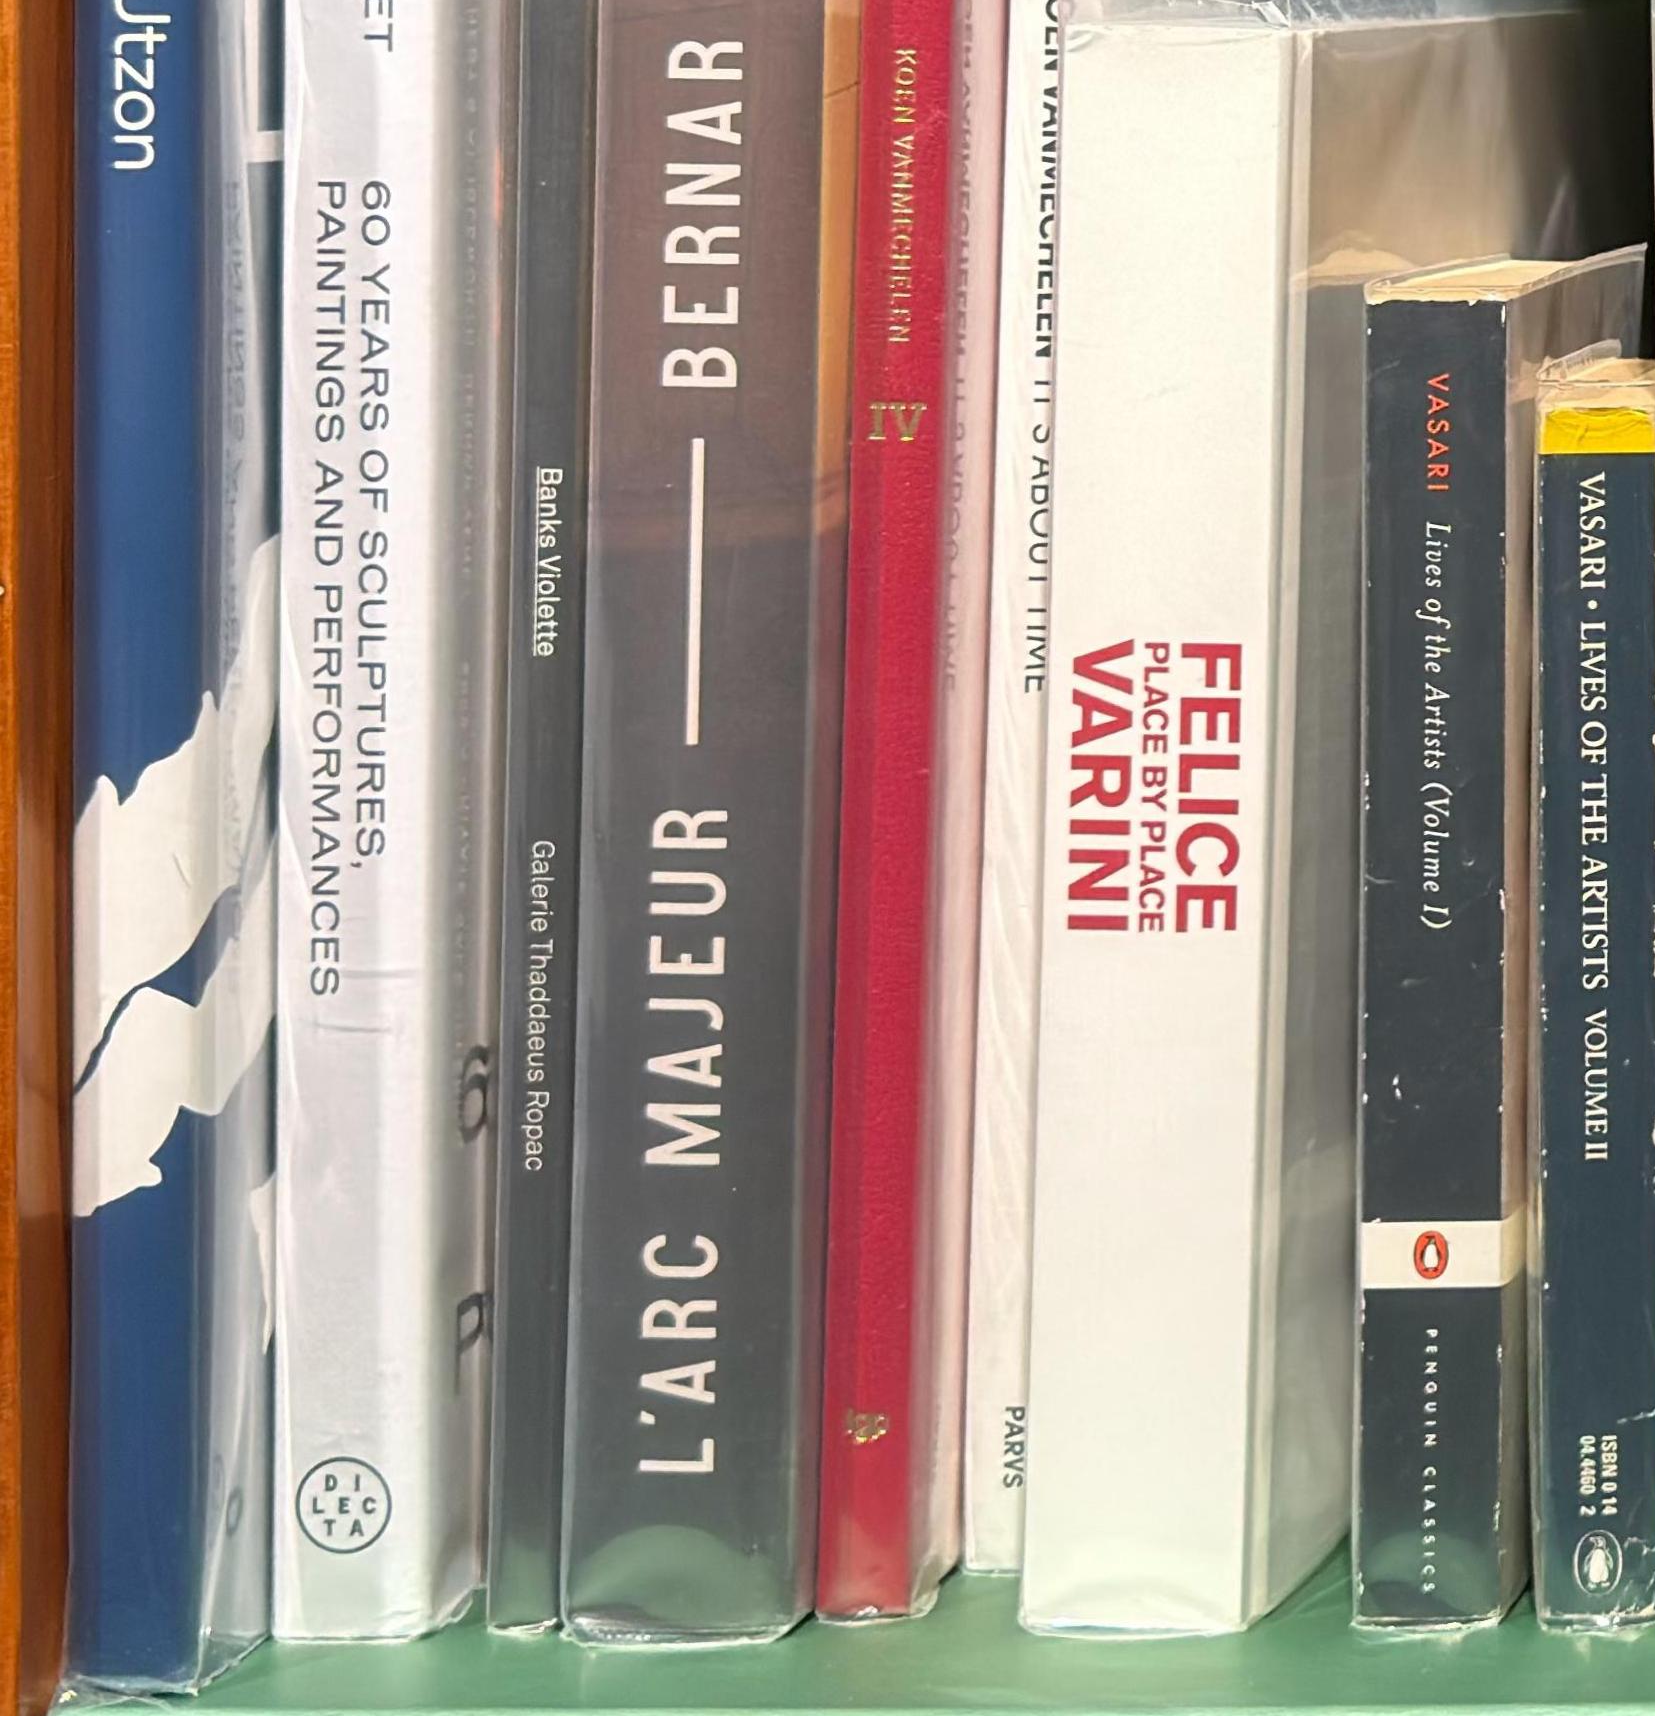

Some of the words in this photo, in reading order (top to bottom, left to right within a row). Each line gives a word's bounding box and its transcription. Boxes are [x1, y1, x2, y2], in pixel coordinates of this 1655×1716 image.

[359, 179, 392, 246] 60
[661, 41, 743, 388] BERNAR
[313, 180, 348, 444] PAINTINGS
[358, 262, 390, 432] YEARS
[868, 402, 927, 442] IV
[1426, 372, 1450, 493] VASARI
[313, 460, 345, 567] AND
[358, 450, 389, 515] OF
[536, 467, 564, 550] Banks
[1578, 473, 1607, 590] VASARI
[533, 556, 559, 658] Violette
[1424, 521, 1451, 588] Lives
[1416, 596, 1450, 623] of
[1424, 627, 1449, 673] the
[350, 528, 389, 872] SCULPTURES,
[1142, 641, 1171, 758] PLACE
[1579, 621, 1607, 711] LIVES
[1423, 682, 1450, 770] Artists
[1579, 720, 1608, 765] OF
[309, 584, 344, 996] PERFORMANCES
[1067, 638, 1135, 933] VARINI
[1140, 763, 1168, 814] BY
[1174, 643, 1243, 934] FELICE
[1420, 782, 1451, 893] (Volume
[1580, 776, 1608, 846] THE
[1138, 820, 1168, 935] PLACE
[1418, 900, 1451, 929] I)
[1581, 854, 1610, 989] ARTISTS
[642, 808, 730, 1166] MAJEUR
[1584, 1009, 1608, 1136] VOLUME
[1584, 1142, 1608, 1160] II
[637, 1233, 720, 1475] L'ARC
